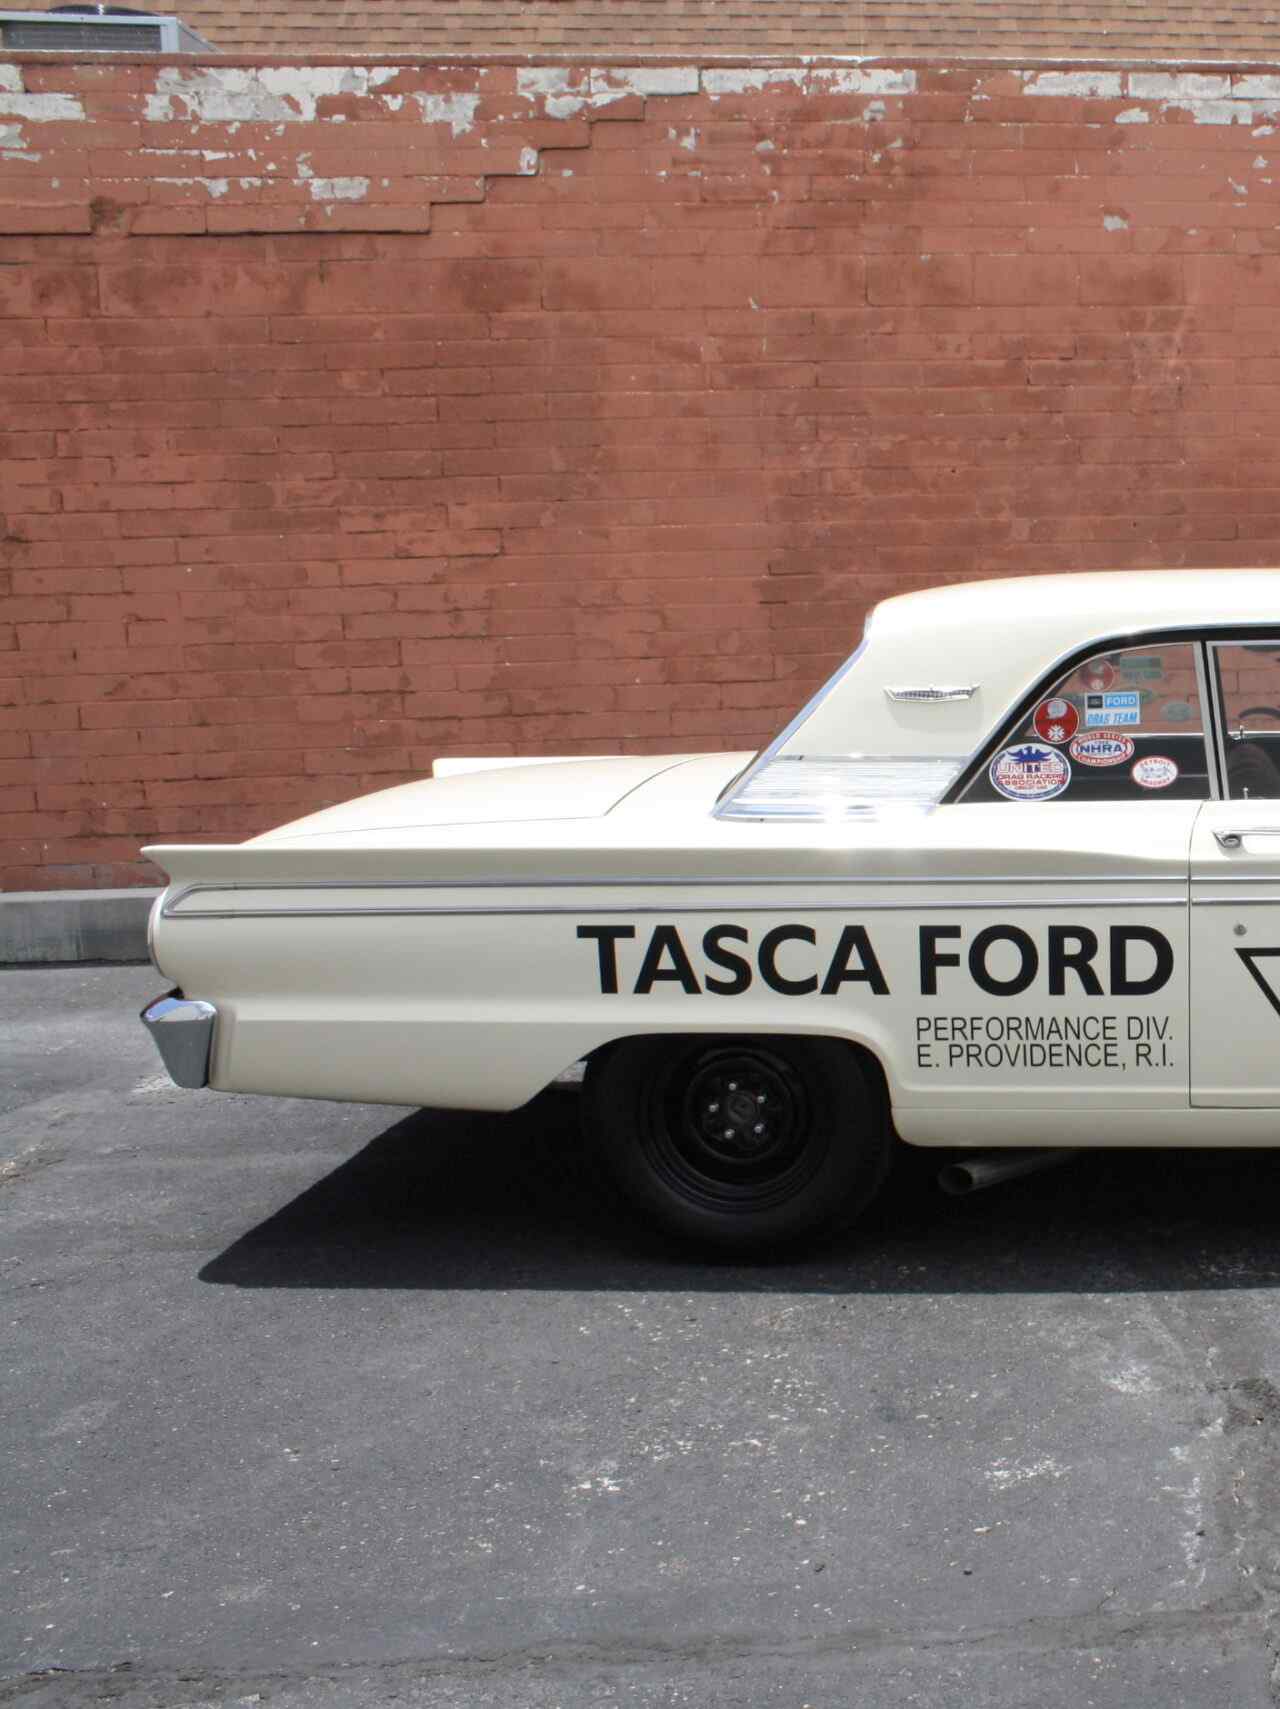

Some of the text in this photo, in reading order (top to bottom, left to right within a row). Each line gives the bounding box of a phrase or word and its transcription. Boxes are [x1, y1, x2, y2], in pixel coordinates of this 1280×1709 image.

[1105, 695, 1137, 705] FORD
[1113, 711, 1137, 724] TEAM
[1079, 744, 1124, 754] NHRA
[577, 924, 1175, 996] TASCA FORD
[916, 1015, 1174, 1041] PERFORMANCE DIV.
[917, 1042, 1175, 1071] E. PROVIDENCE, R.I.
